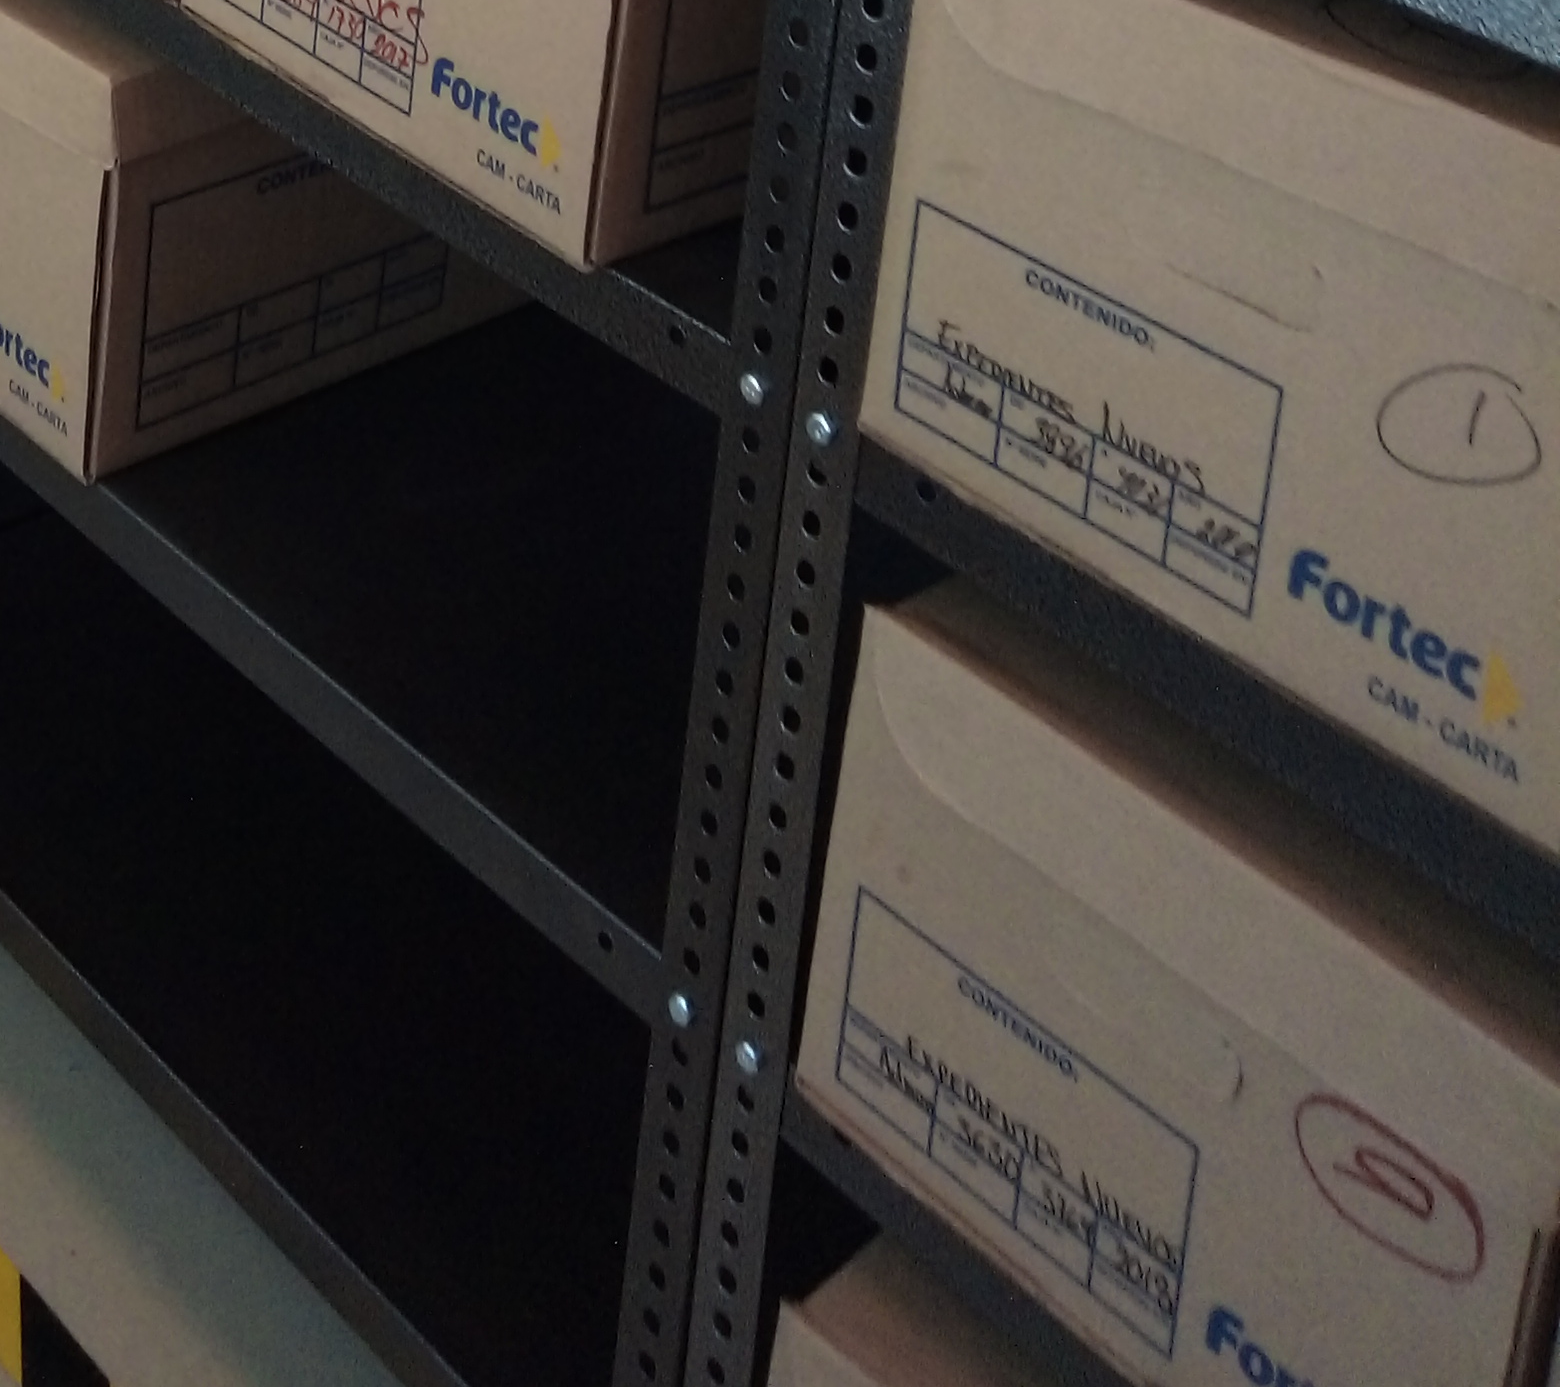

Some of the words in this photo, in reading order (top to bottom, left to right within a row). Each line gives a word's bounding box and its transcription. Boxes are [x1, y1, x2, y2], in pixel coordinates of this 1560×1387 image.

[431, 58, 539, 156] Fortec
[476, 148, 506, 178] CAM
[516, 172, 562, 215] CARTA
[1026, 268, 1155, 352] CONTENIDO:
[9, 379, 29, 405] CAM
[37, 401, 68, 436] CARTA
[1287, 548, 1482, 702] Fortec
[1367, 675, 1419, 722] CAM
[1440, 720, 1521, 783] CARTA
[957, 975, 1078, 1083] CONTENIDO:
